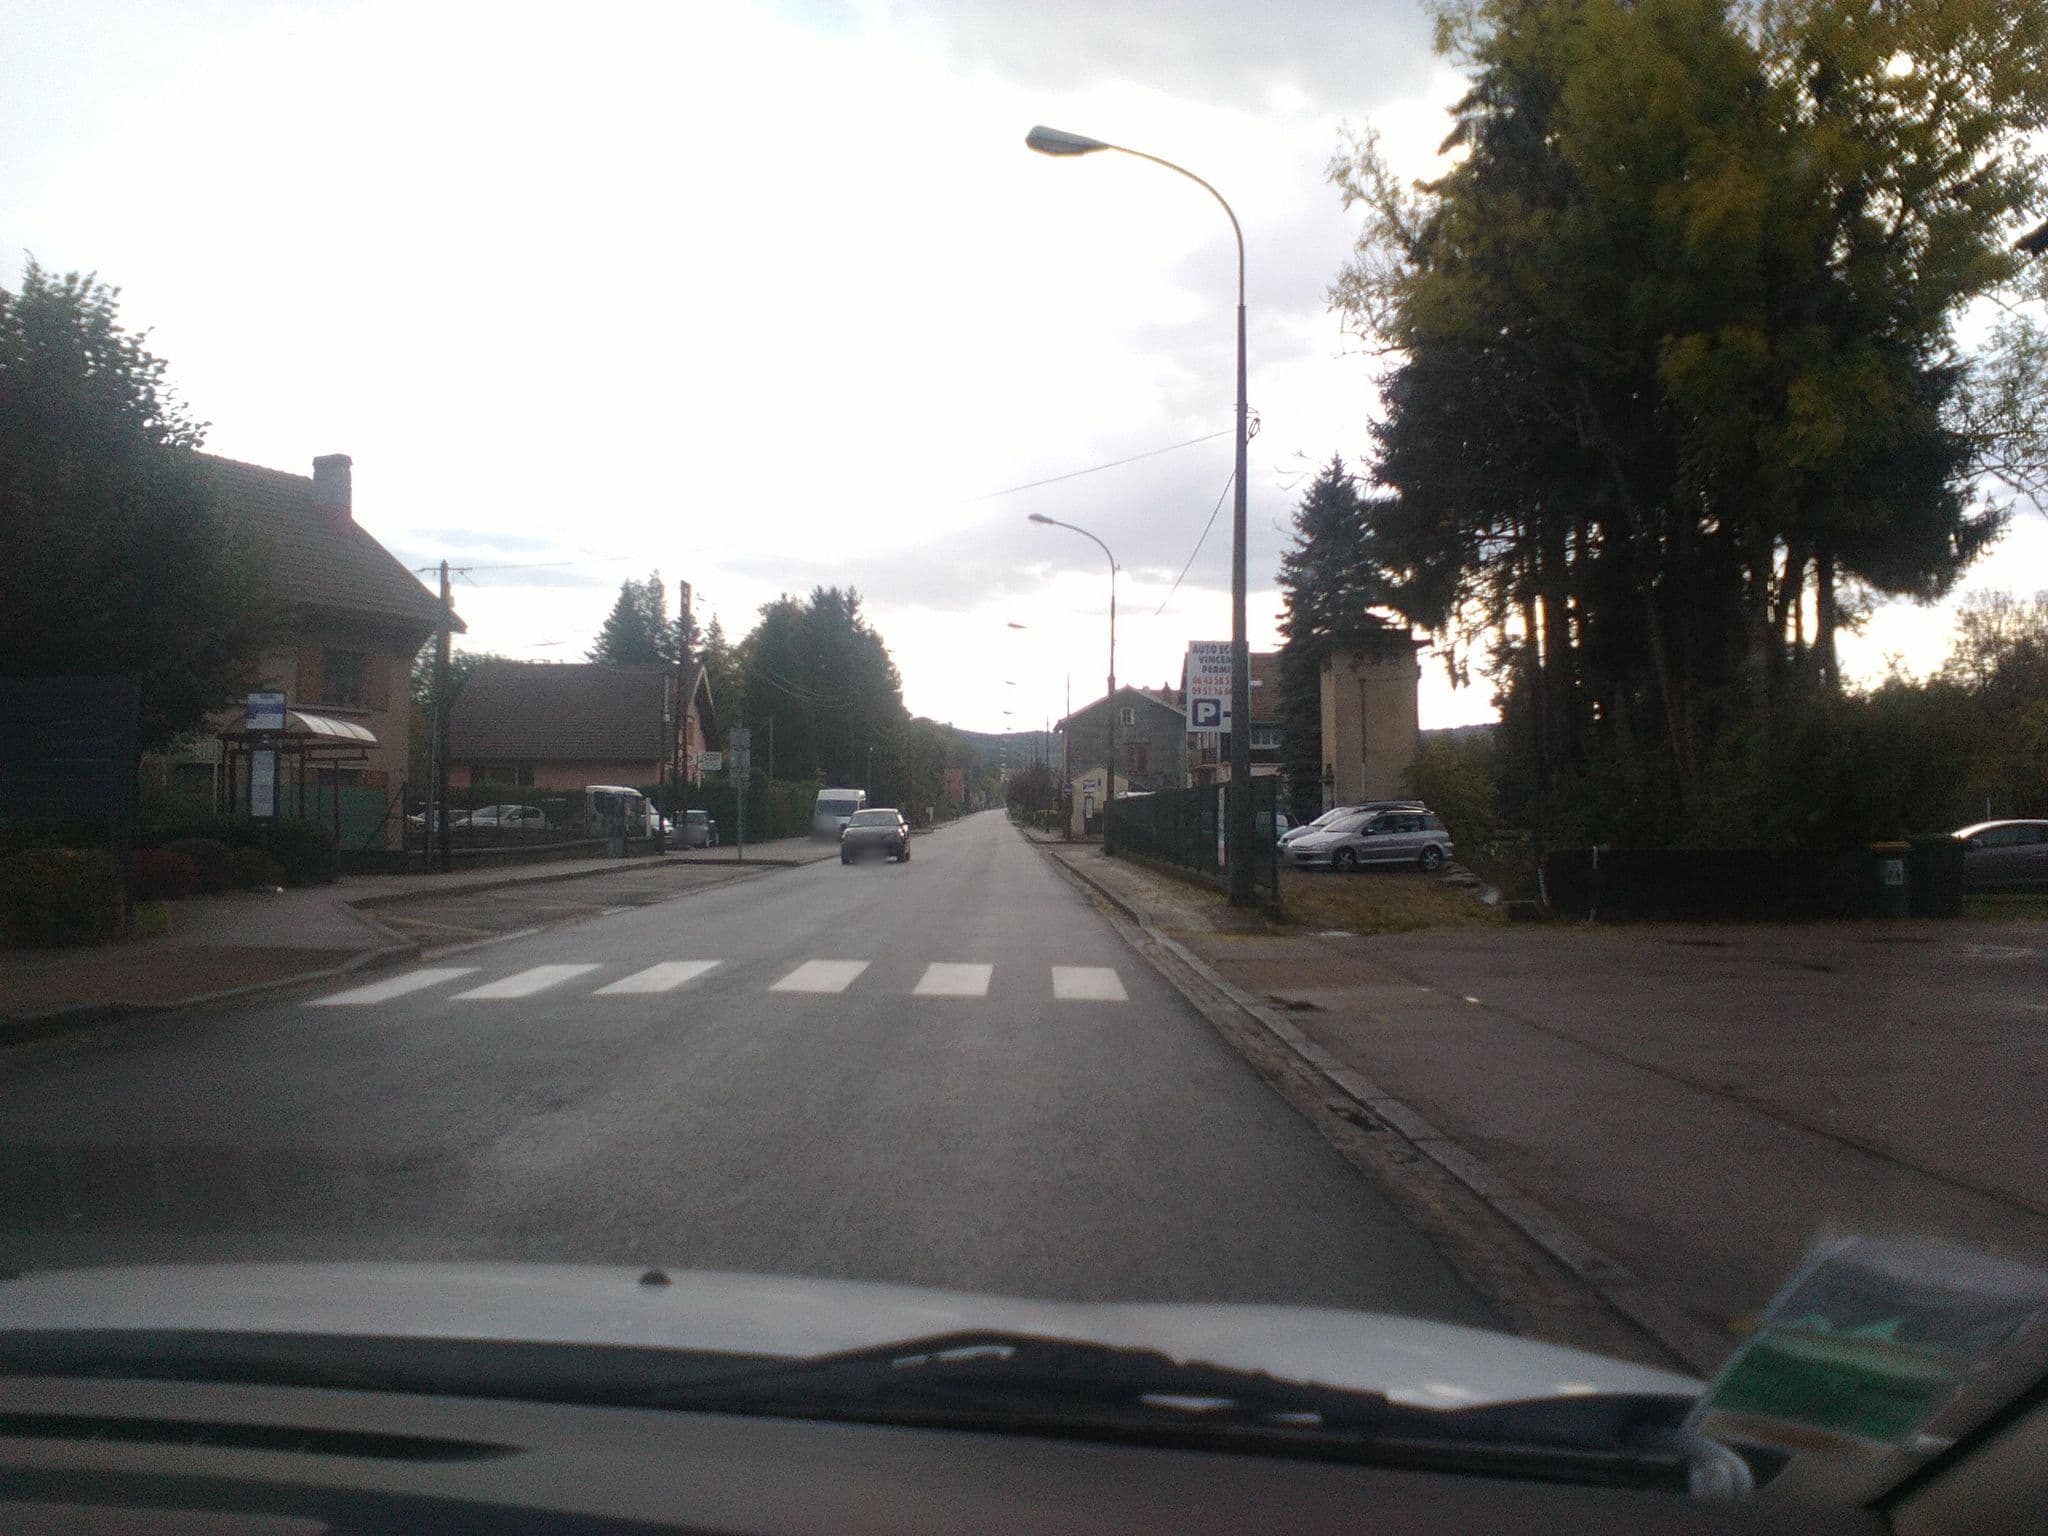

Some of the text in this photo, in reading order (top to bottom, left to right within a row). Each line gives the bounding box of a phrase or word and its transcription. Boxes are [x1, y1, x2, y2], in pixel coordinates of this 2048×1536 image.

[1192, 644, 1232, 654] AUTO EC
[1198, 655, 1232, 664] VINCEN
[1201, 665, 1232, 673] PERMI
[1224, 676, 1231, 685] 5
[1197, 703, 1216, 722] P
